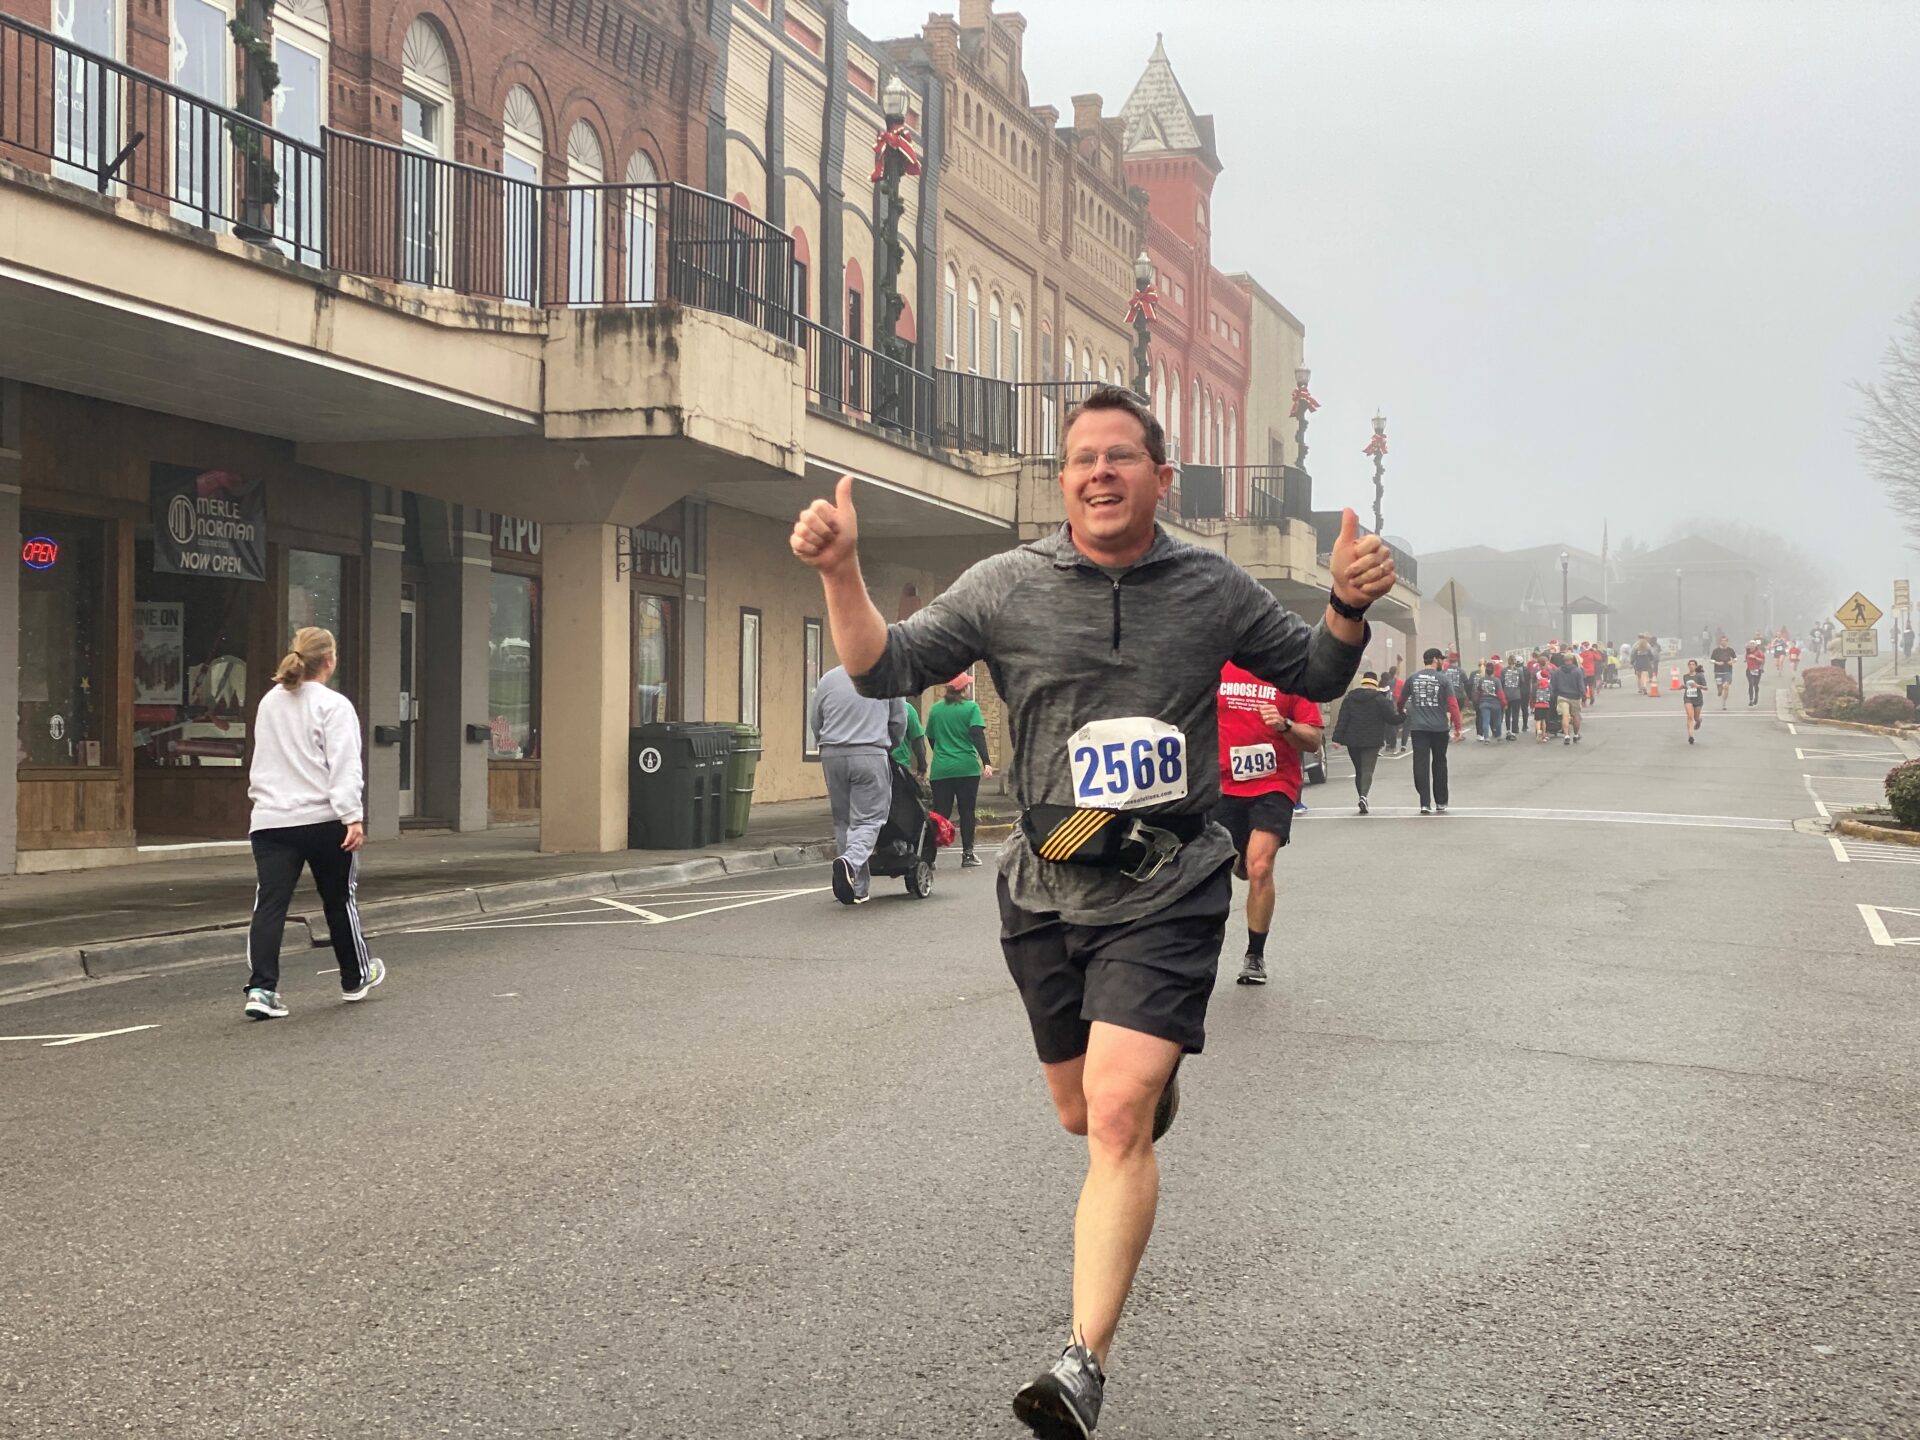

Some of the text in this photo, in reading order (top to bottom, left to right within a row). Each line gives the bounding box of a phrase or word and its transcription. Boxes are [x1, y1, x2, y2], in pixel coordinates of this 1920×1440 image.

[196, 497, 240, 519] MERLE
[197, 518, 254, 541] NORMAN
[22, 543, 58, 562] OPEN
[180, 551, 242, 573] NOW OPEN
[160, 608, 179, 627] ON
[1219, 682, 1277, 701] CHOOSE LIFE
[1074, 736, 1182, 798] 2568
[1232, 752, 1275, 775] 2493
